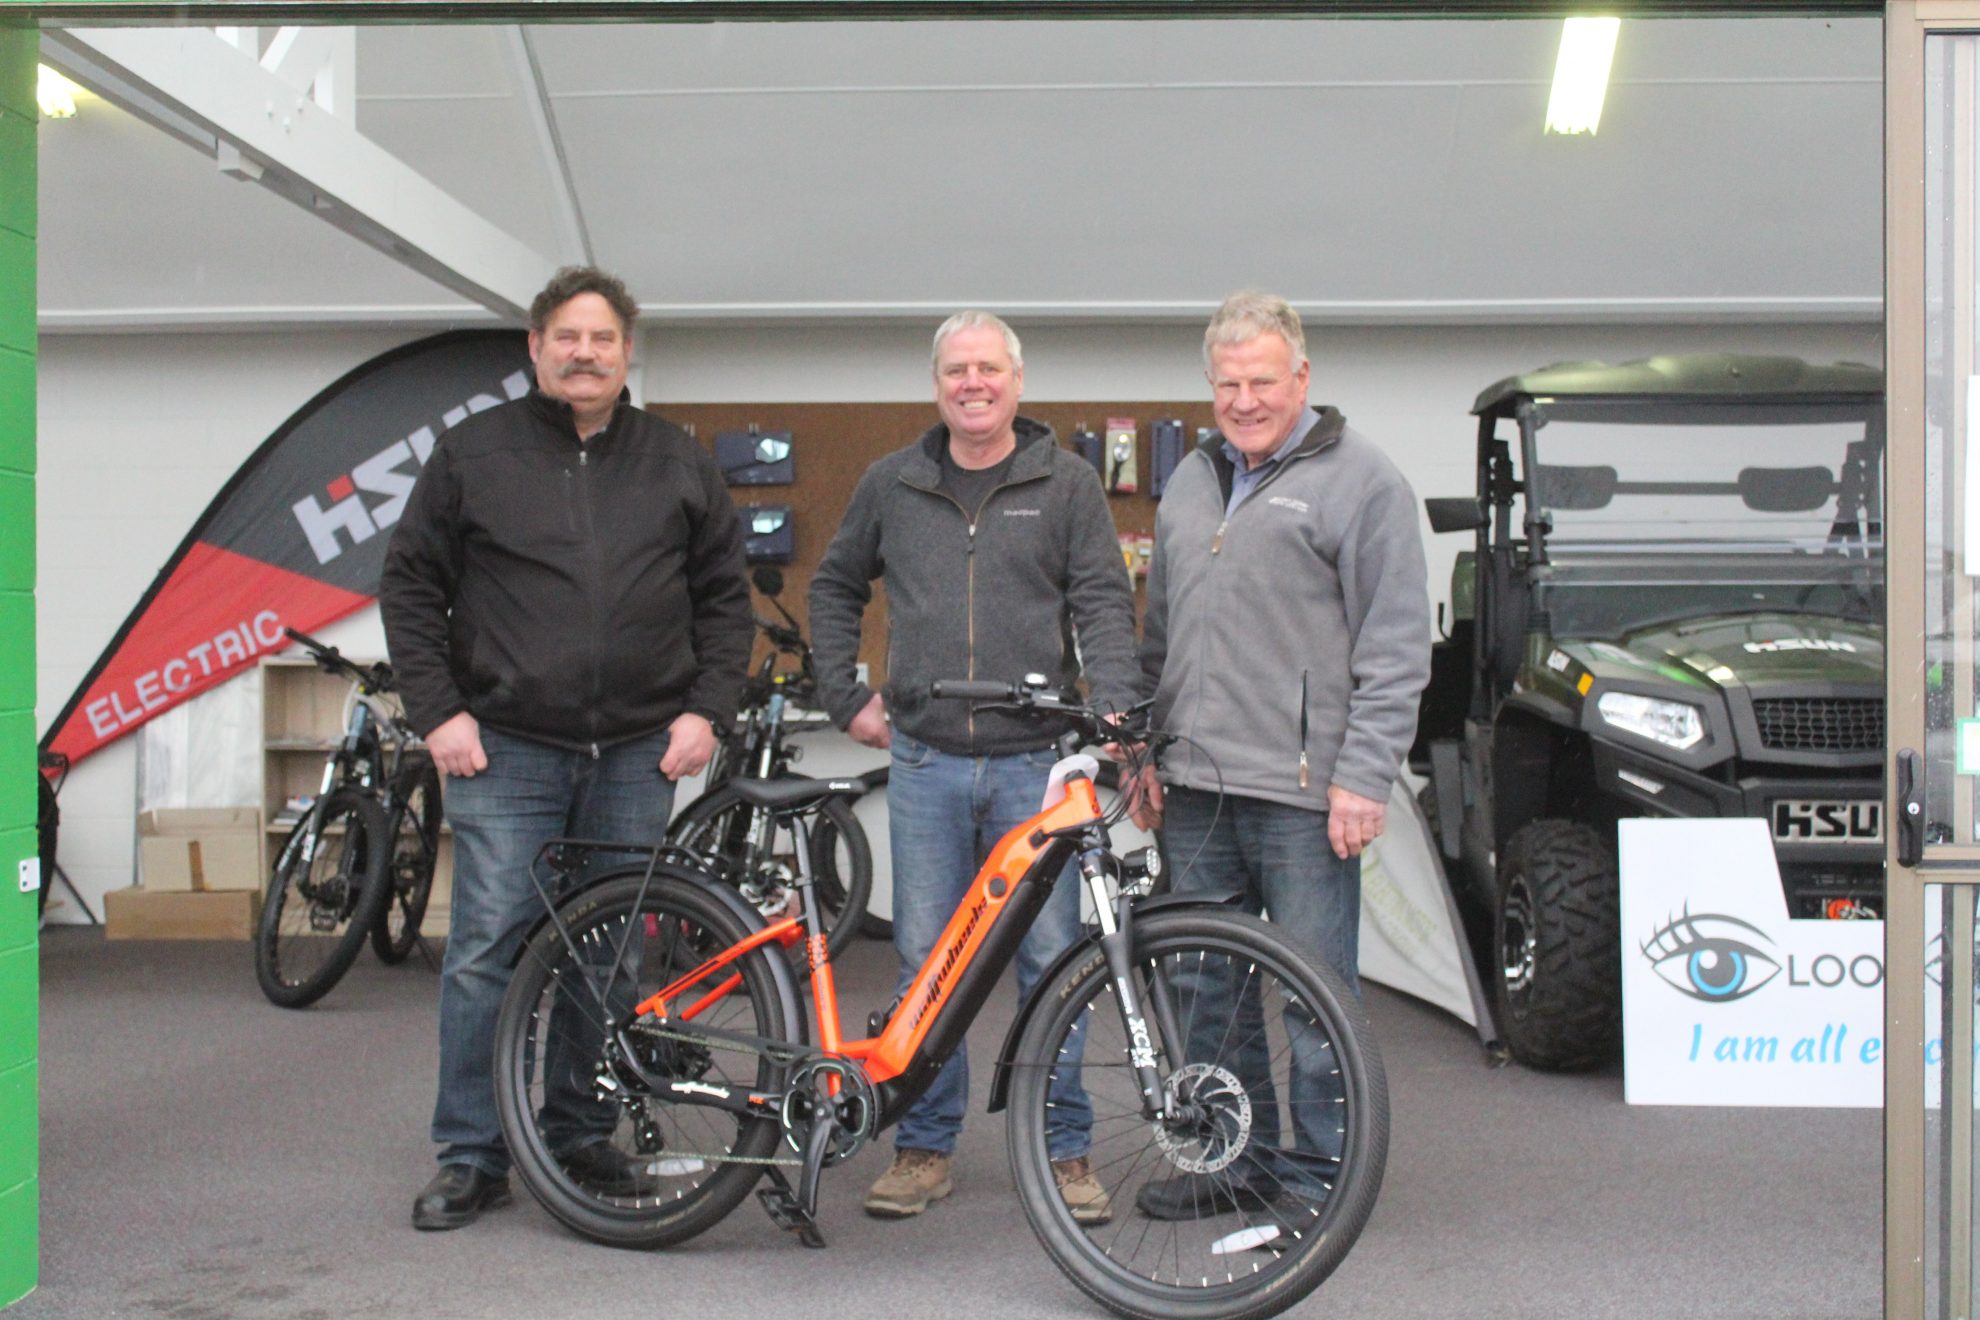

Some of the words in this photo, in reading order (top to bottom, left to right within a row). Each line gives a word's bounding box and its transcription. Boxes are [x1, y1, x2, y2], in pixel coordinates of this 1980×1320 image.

[292, 370, 531, 566] HIS
[85, 609, 285, 740] ELECTRIC
[1776, 803, 1879, 838] HISU
[1788, 954, 1884, 988] LOO
[1688, 1023, 1703, 1062] I
[1713, 1036, 1779, 1063] am
[1790, 1023, 1848, 1064] all
